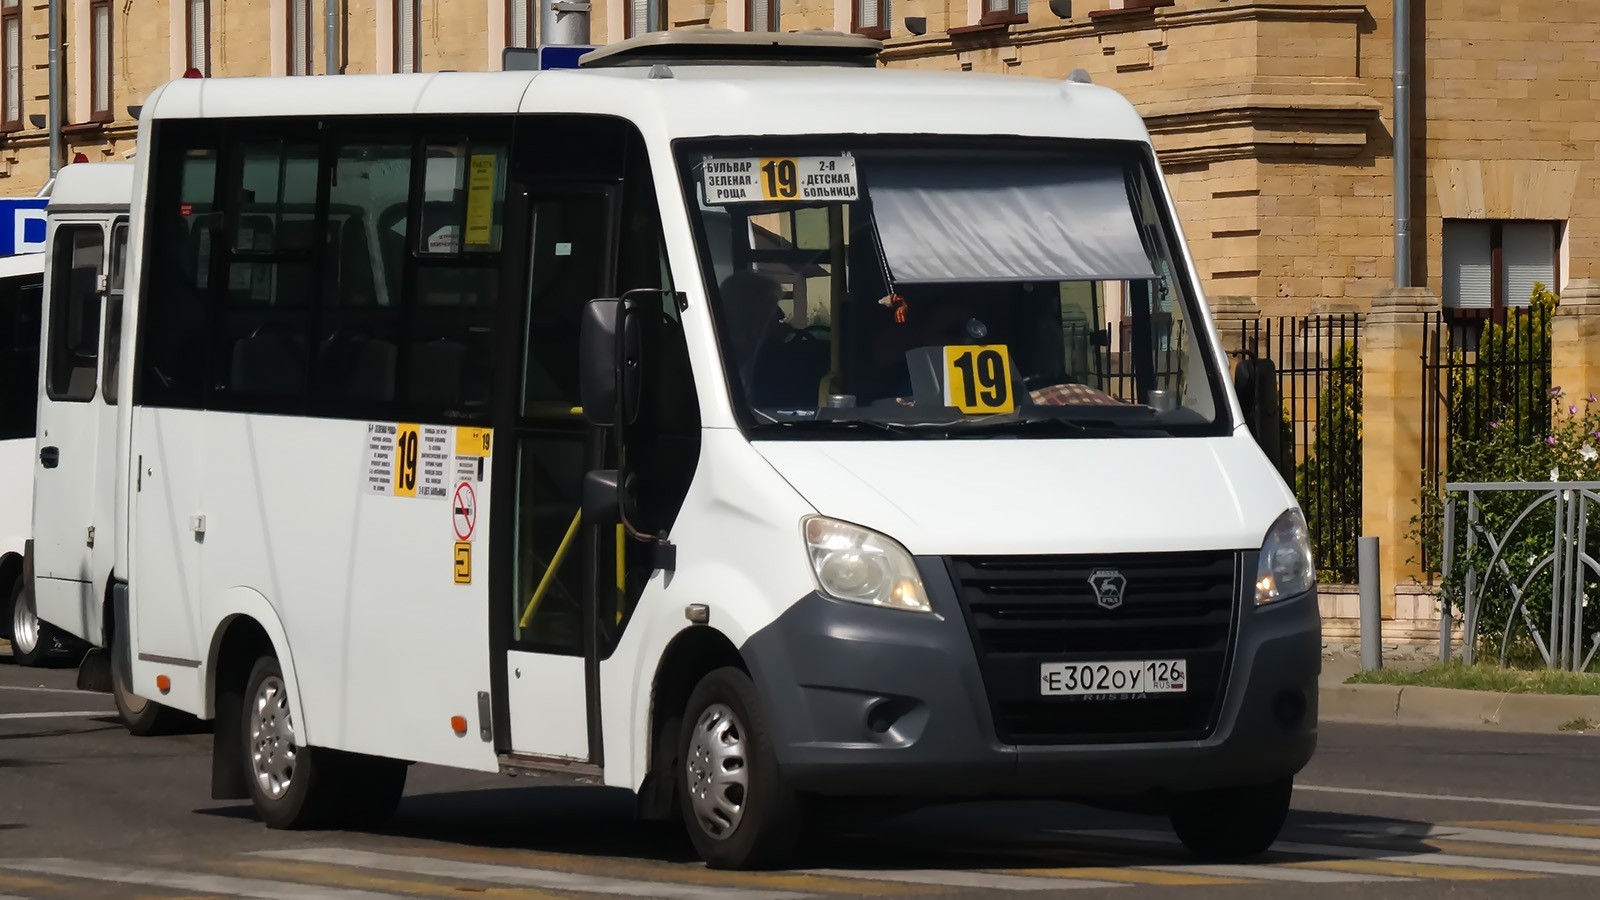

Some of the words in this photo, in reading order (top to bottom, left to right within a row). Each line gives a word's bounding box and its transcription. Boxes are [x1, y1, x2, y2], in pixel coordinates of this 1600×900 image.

[707, 161, 752, 173] БУЛЬВАР
[819, 161, 835, 172] 2-Я
[709, 175, 752, 187] ЗЕЛЕНАЯ
[762, 159, 798, 198] 19
[807, 174, 850, 186] ДЕТСКАЯ
[717, 188, 747, 199] РОЩА
[803, 186, 857, 197] БОЛЬНИЦА
[954, 350, 1008, 408] 19
[482, 433, 490, 451] 19
[398, 430, 418, 491] 19
[1147, 662, 1180, 682] 126
[1153, 681, 1171, 689] RUS
[1083, 692, 1147, 701] RUSSIA
